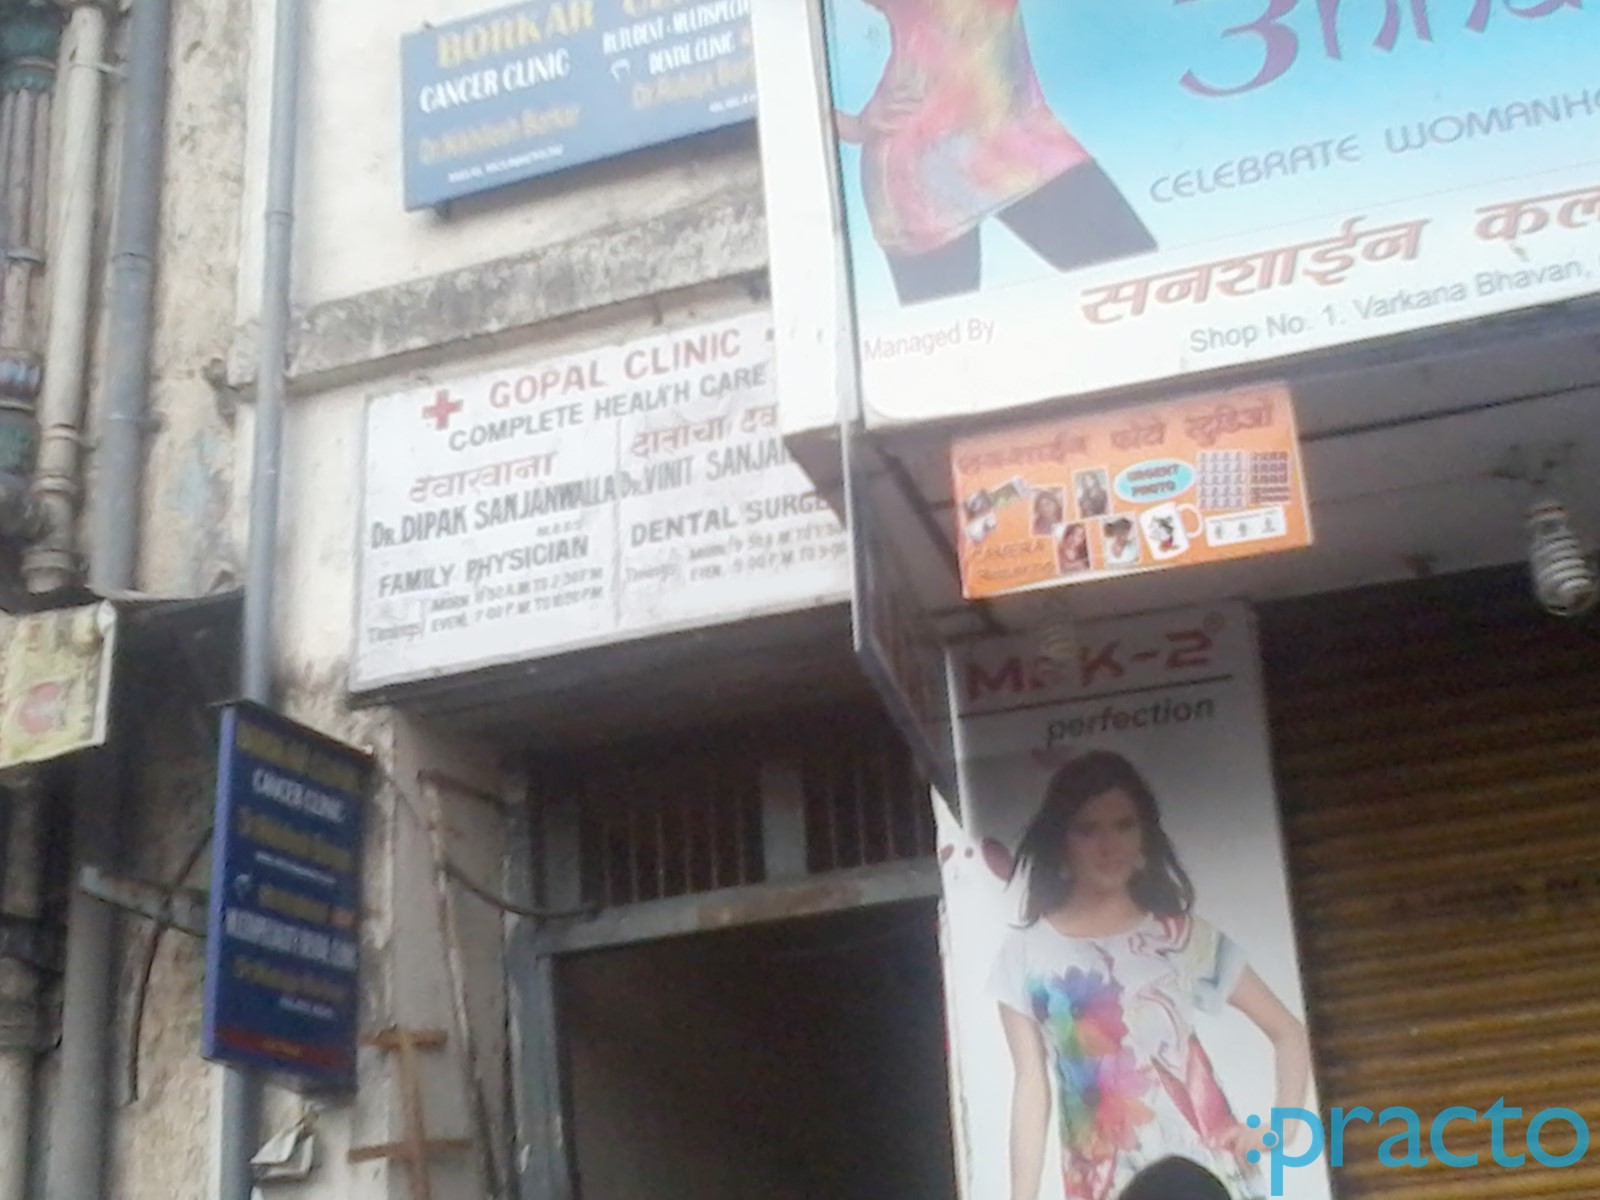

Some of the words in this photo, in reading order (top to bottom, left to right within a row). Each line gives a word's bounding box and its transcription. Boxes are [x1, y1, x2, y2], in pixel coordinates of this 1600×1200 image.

[419, 68, 499, 114] CANCER
[503, 47, 571, 92] CLINIC
[1150, 134, 1361, 204] CELEBRATE
[1080, 215, 1431, 324] सनशाईन
[863, 320, 961, 362] Managed
[968, 317, 995, 345] By
[1190, 323, 1259, 352] Shop
[1266, 312, 1312, 337] No.
[1352, 282, 1467, 320] Varkana
[489, 360, 608, 409] GOPAL
[625, 329, 741, 380] CLINIC
[449, 402, 583, 452] COMPLETE
[701, 362, 768, 397] CARE
[643, 455, 694, 492] VINIT
[401, 505, 467, 543] DIPAK
[473, 473, 617, 530] SANJANWALLA
[631, 506, 738, 548] DENTAL
[378, 563, 455, 598] FAMILY
[466, 535, 589, 582] PHYSICIAN
[1048, 697, 1215, 748] perfection
